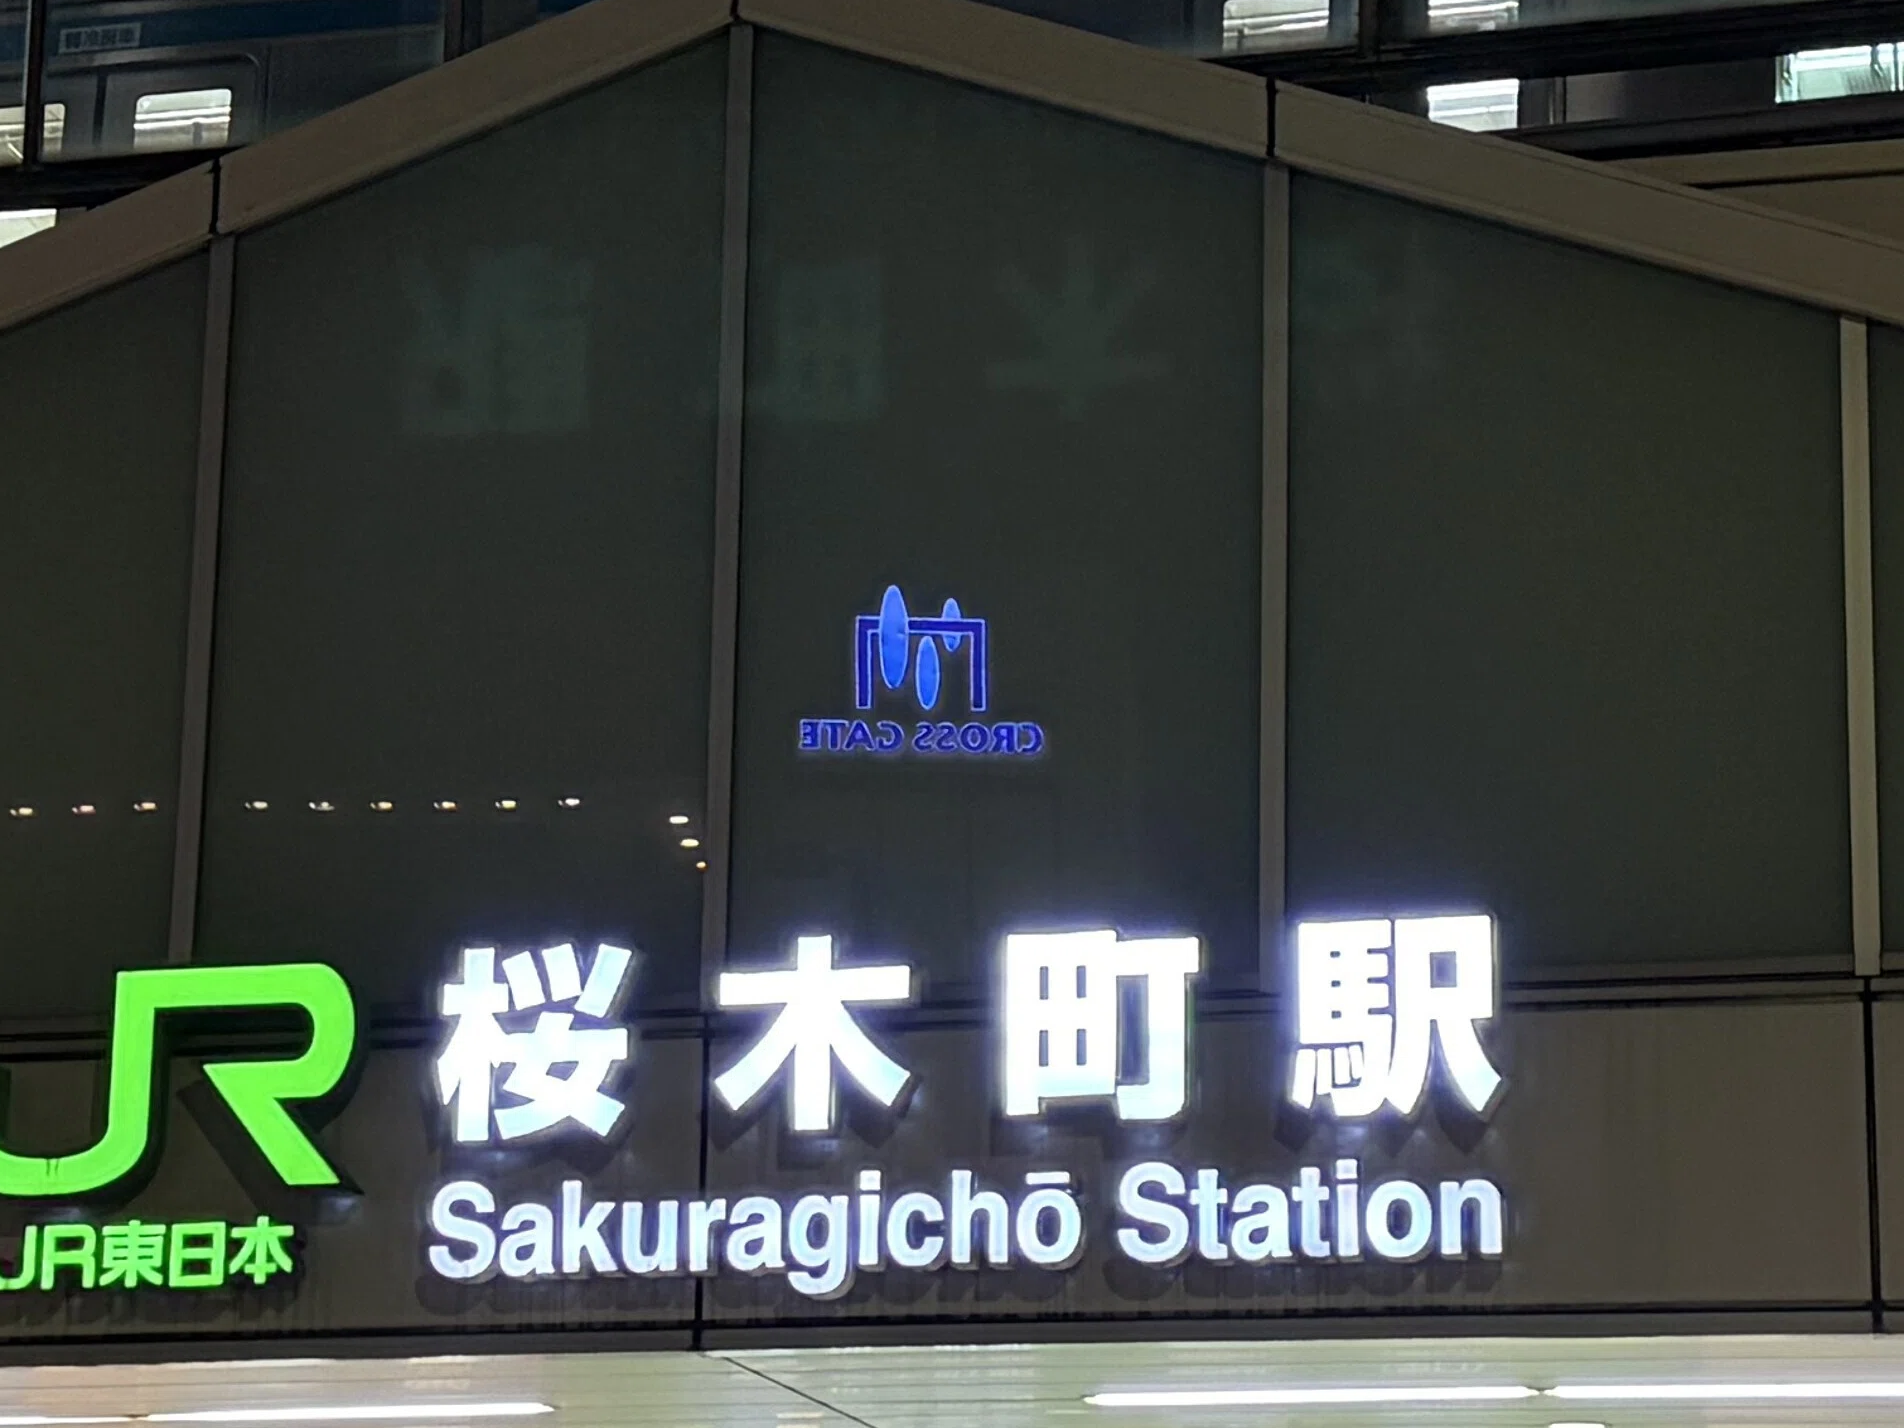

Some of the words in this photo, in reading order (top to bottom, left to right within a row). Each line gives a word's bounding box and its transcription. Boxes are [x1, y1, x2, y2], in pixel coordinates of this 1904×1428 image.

[437, 912, 1501, 1144] 桜木町駅
[428, 1169, 1081, 1297] Sakuragichō
[1116, 1157, 1506, 1265] Station
